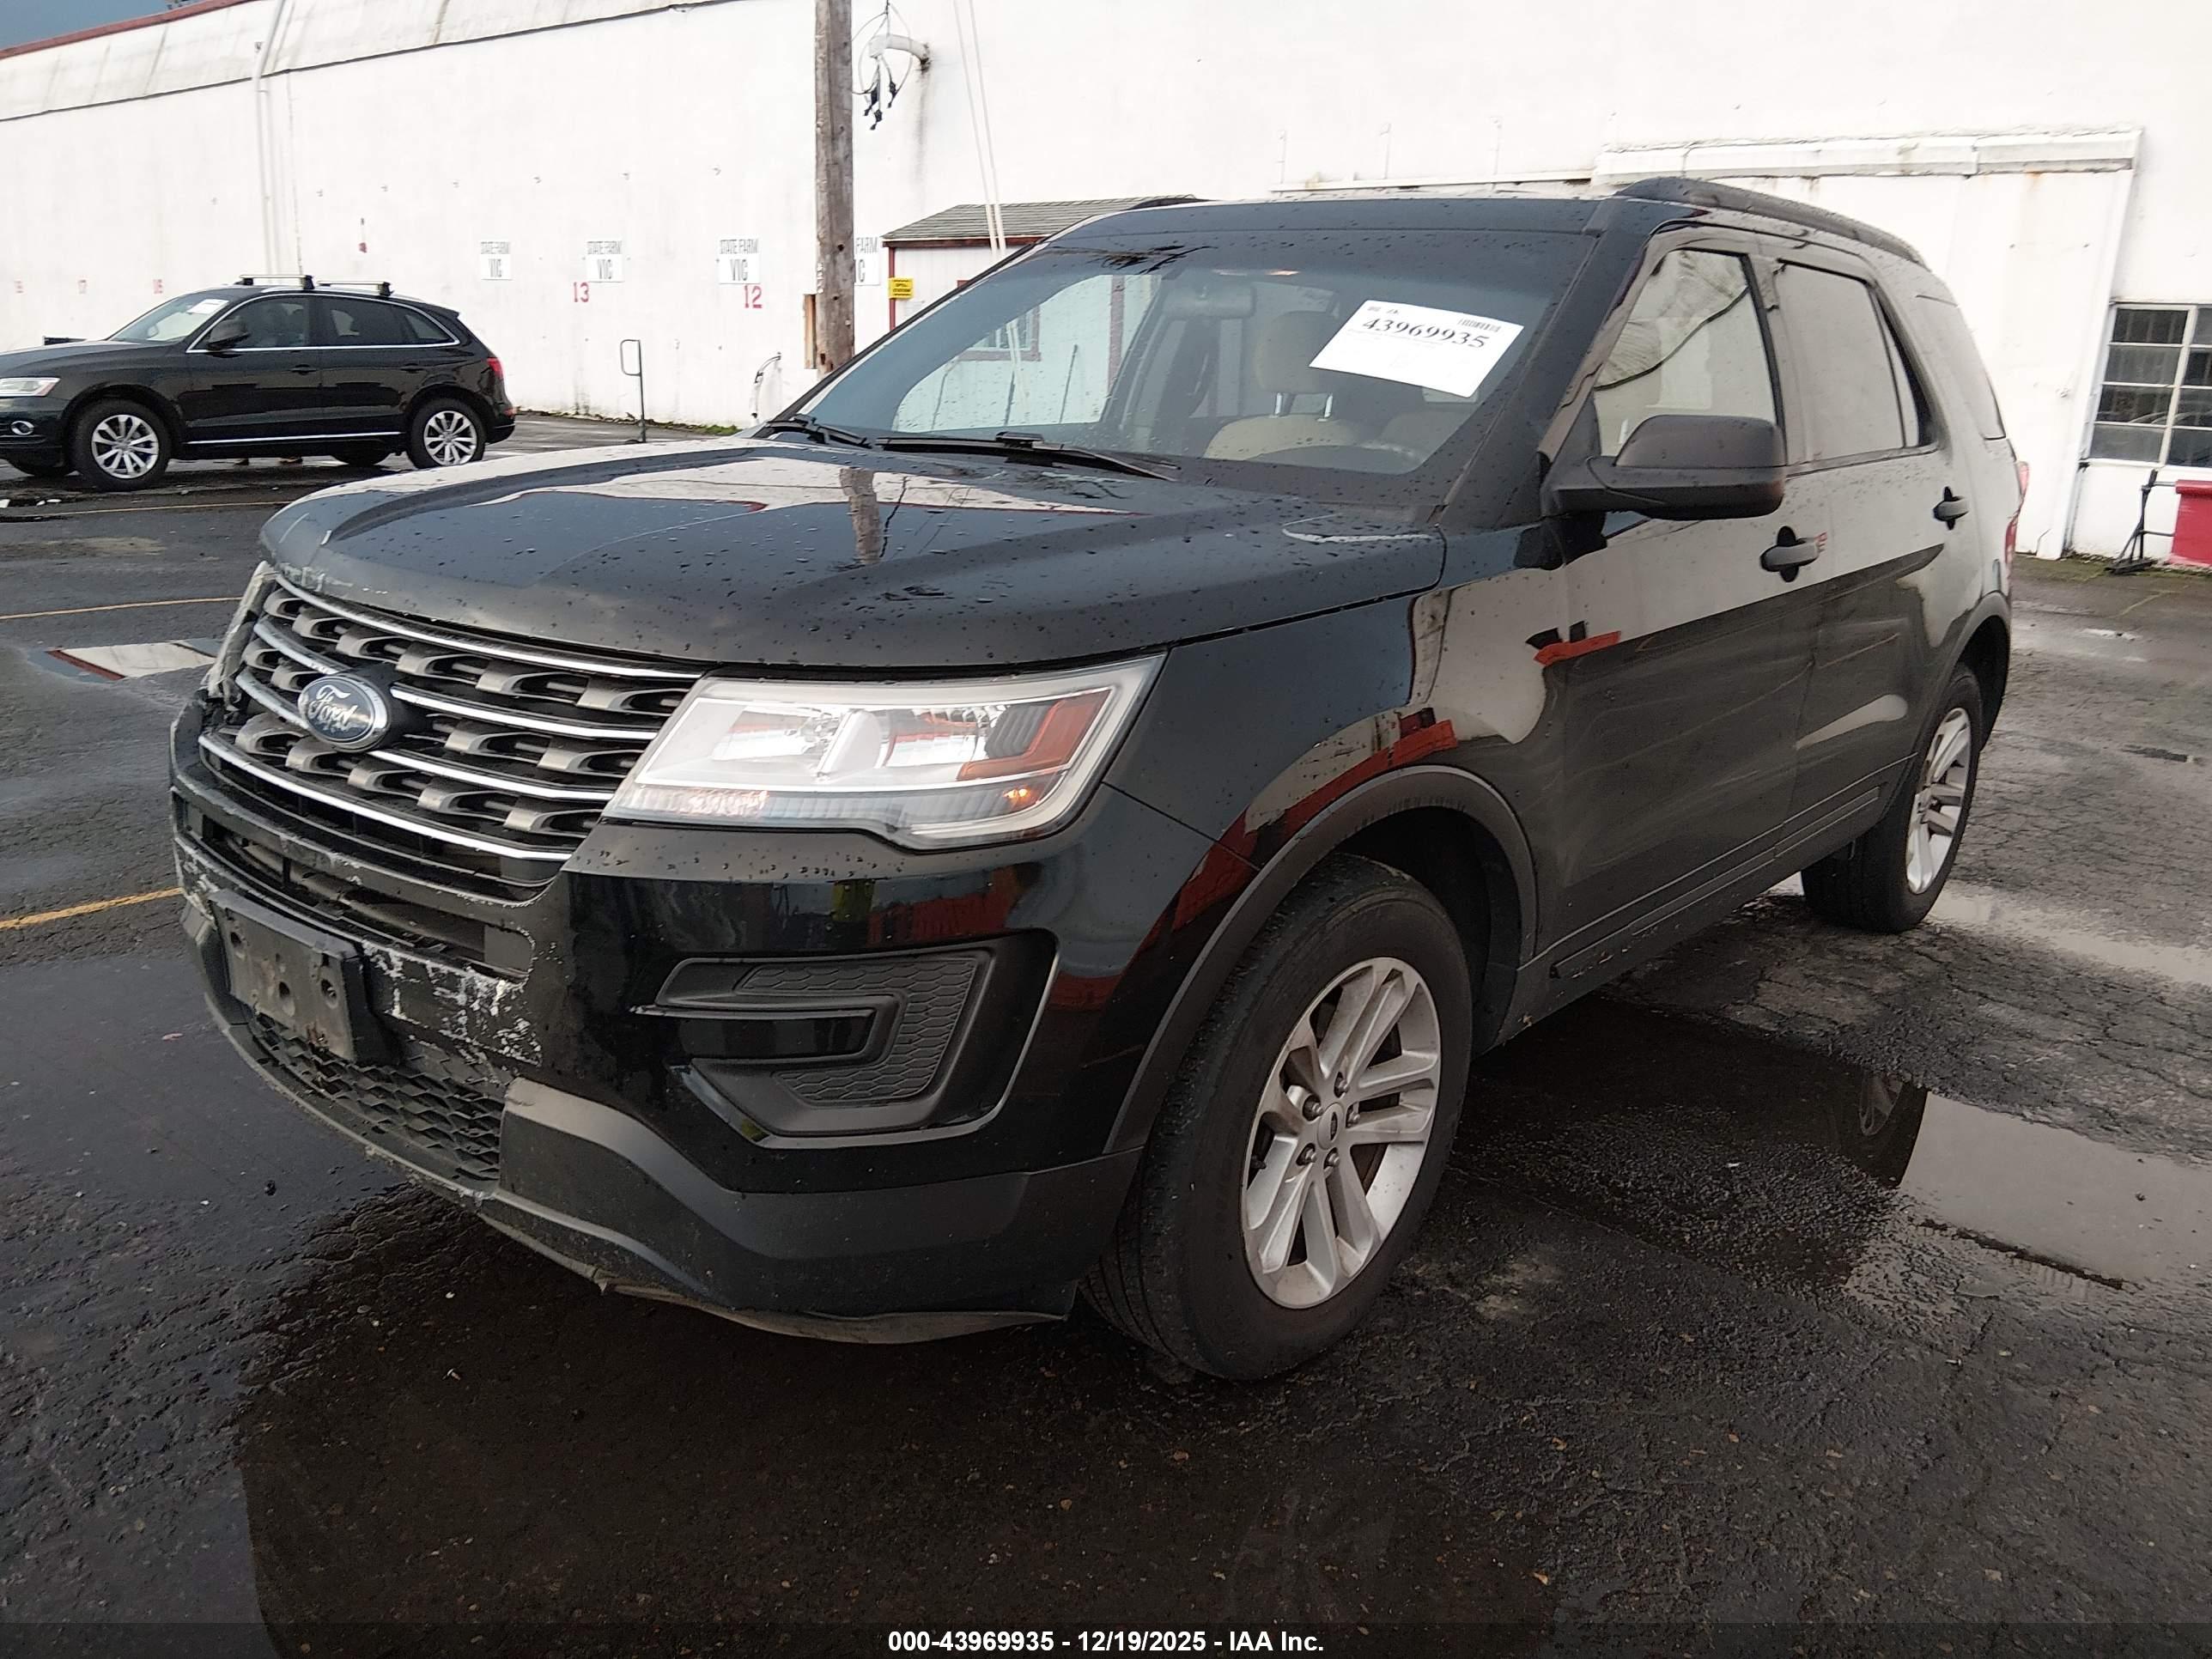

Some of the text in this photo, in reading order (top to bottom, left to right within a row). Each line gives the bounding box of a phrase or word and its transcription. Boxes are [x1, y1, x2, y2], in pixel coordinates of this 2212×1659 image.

[730, 258, 749, 282] VIC
[573, 282, 590, 303] 13
[744, 285, 763, 309] 12
[1362, 318, 1491, 349] 43969935
[307, 684, 359, 732] Ford
